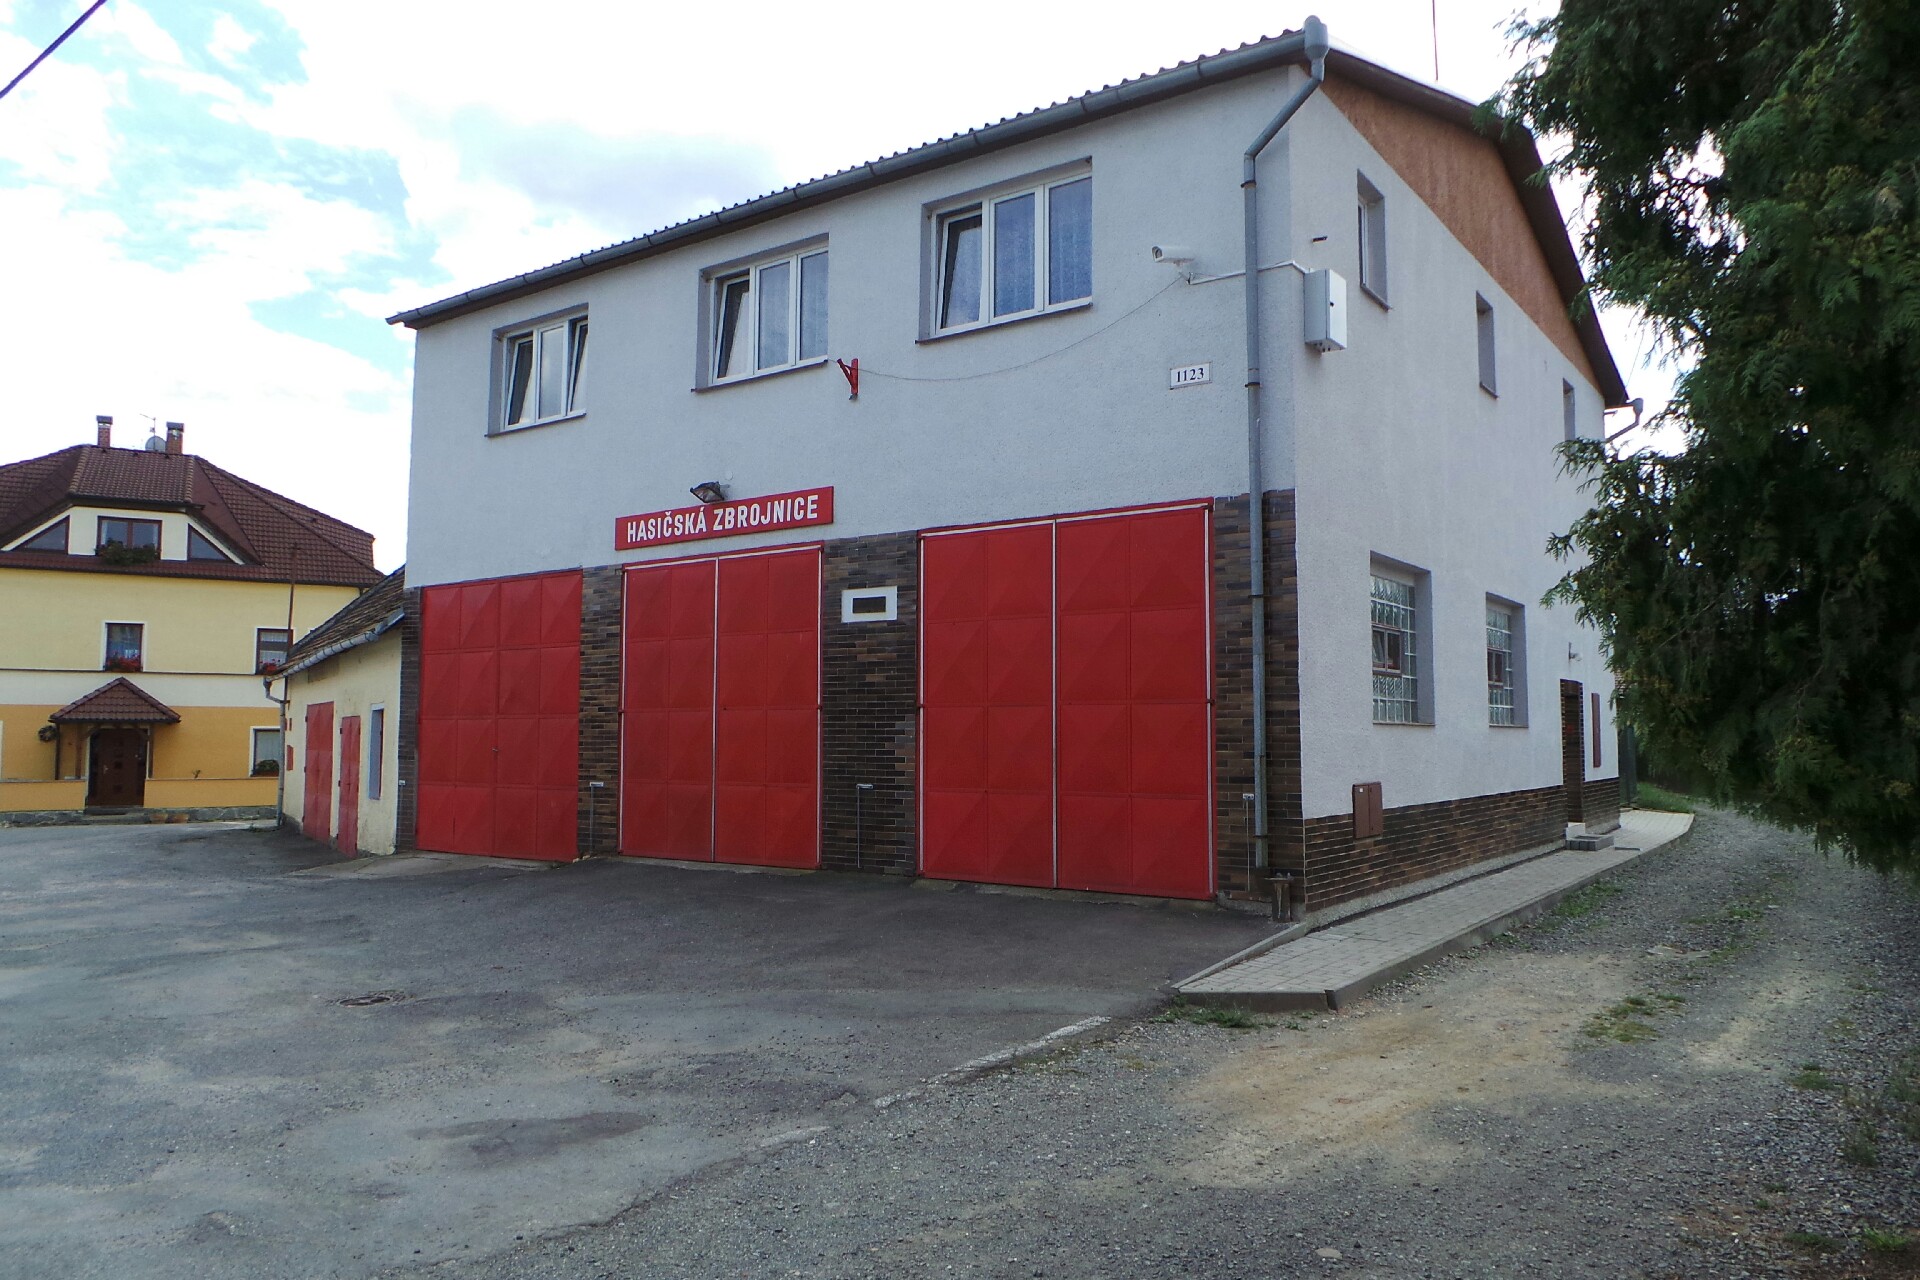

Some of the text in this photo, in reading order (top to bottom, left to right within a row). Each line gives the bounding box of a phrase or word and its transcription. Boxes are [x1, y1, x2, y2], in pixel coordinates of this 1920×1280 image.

[1176, 367, 1204, 382] 1123
[627, 494, 819, 543] HASIČSKÁ ZBROJNICE
